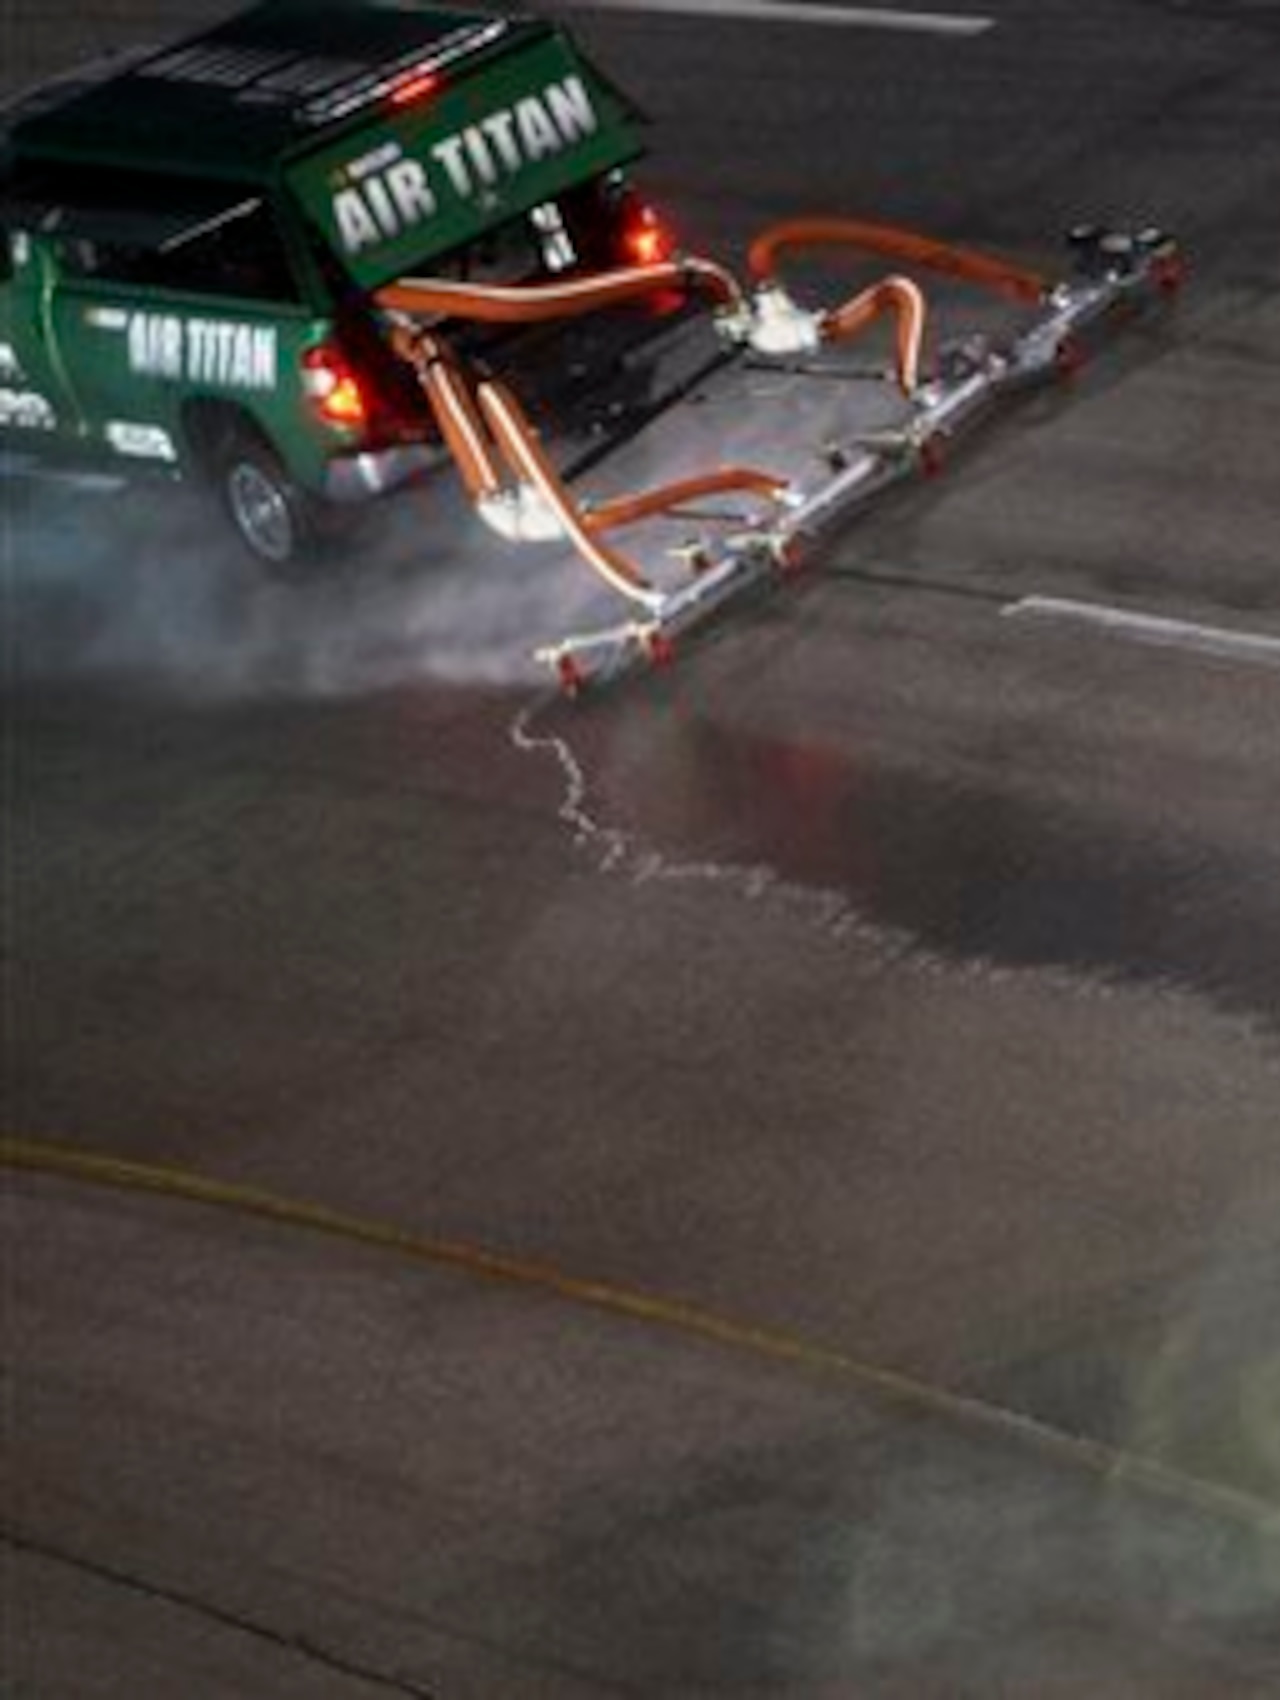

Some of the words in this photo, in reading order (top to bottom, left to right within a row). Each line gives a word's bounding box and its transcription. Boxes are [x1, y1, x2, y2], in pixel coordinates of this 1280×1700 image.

[332, 159, 437, 253] AIR
[432, 75, 598, 198] TITAN
[186, 317, 277, 391] TITAN
